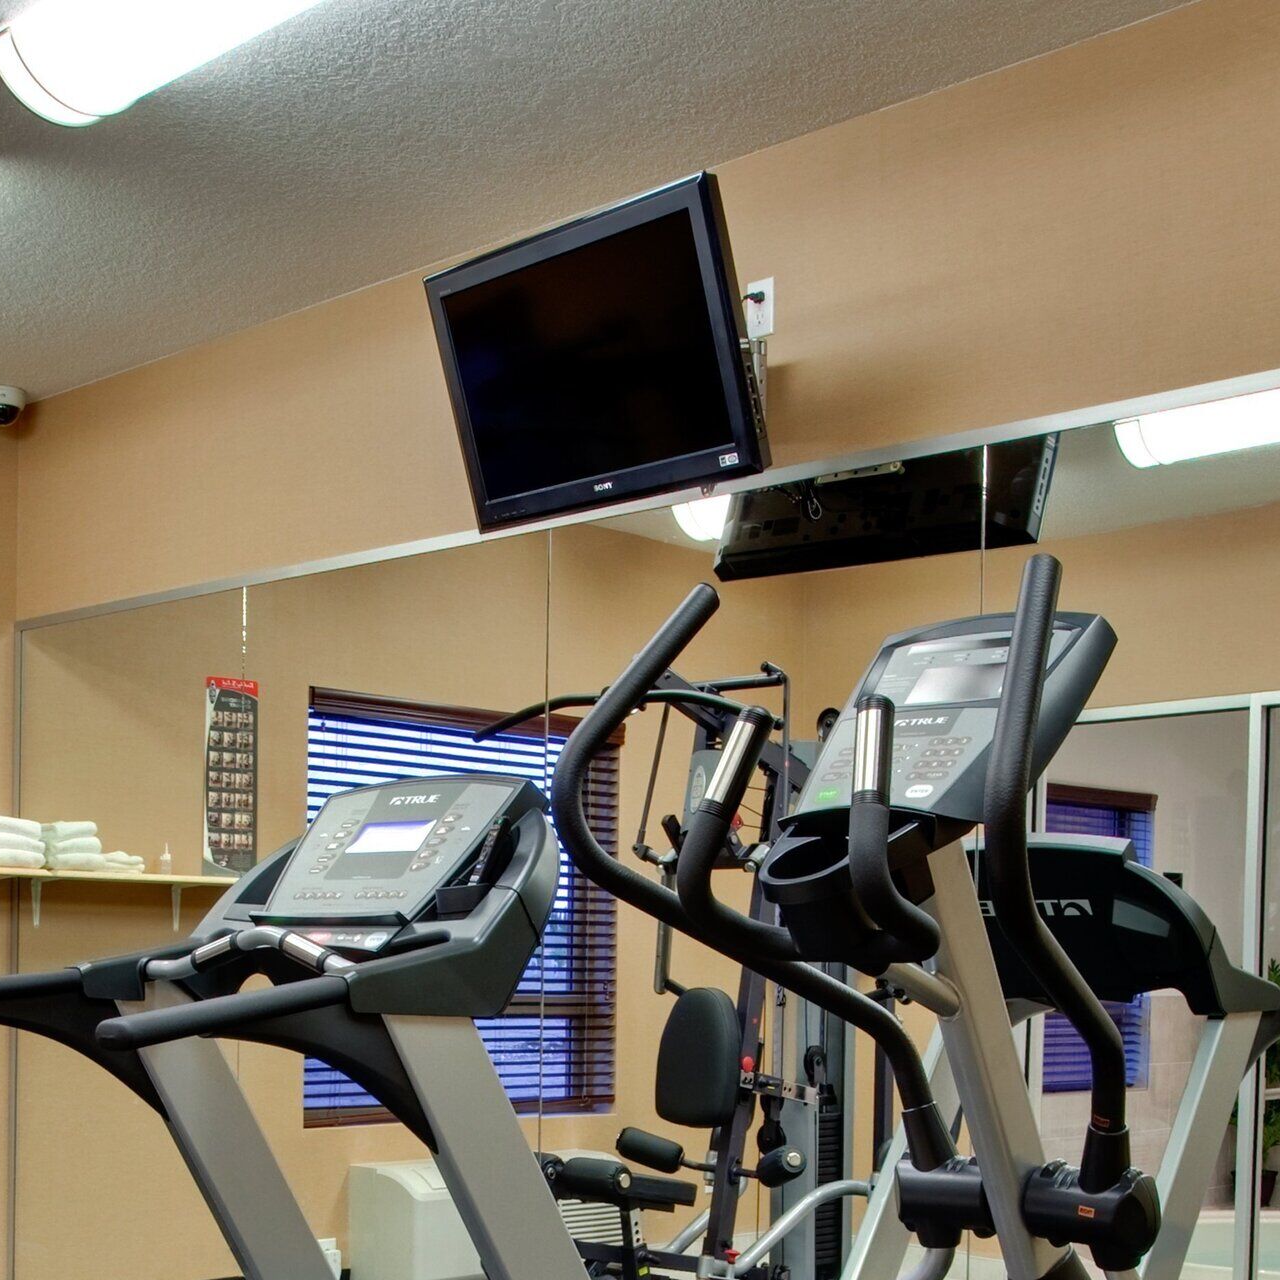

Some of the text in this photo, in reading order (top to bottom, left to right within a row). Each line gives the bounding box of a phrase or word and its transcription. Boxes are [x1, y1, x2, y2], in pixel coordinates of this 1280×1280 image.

[593, 481, 613, 492] SONY
[910, 716, 949, 726] TRUE
[404, 794, 441, 805] TRUE
